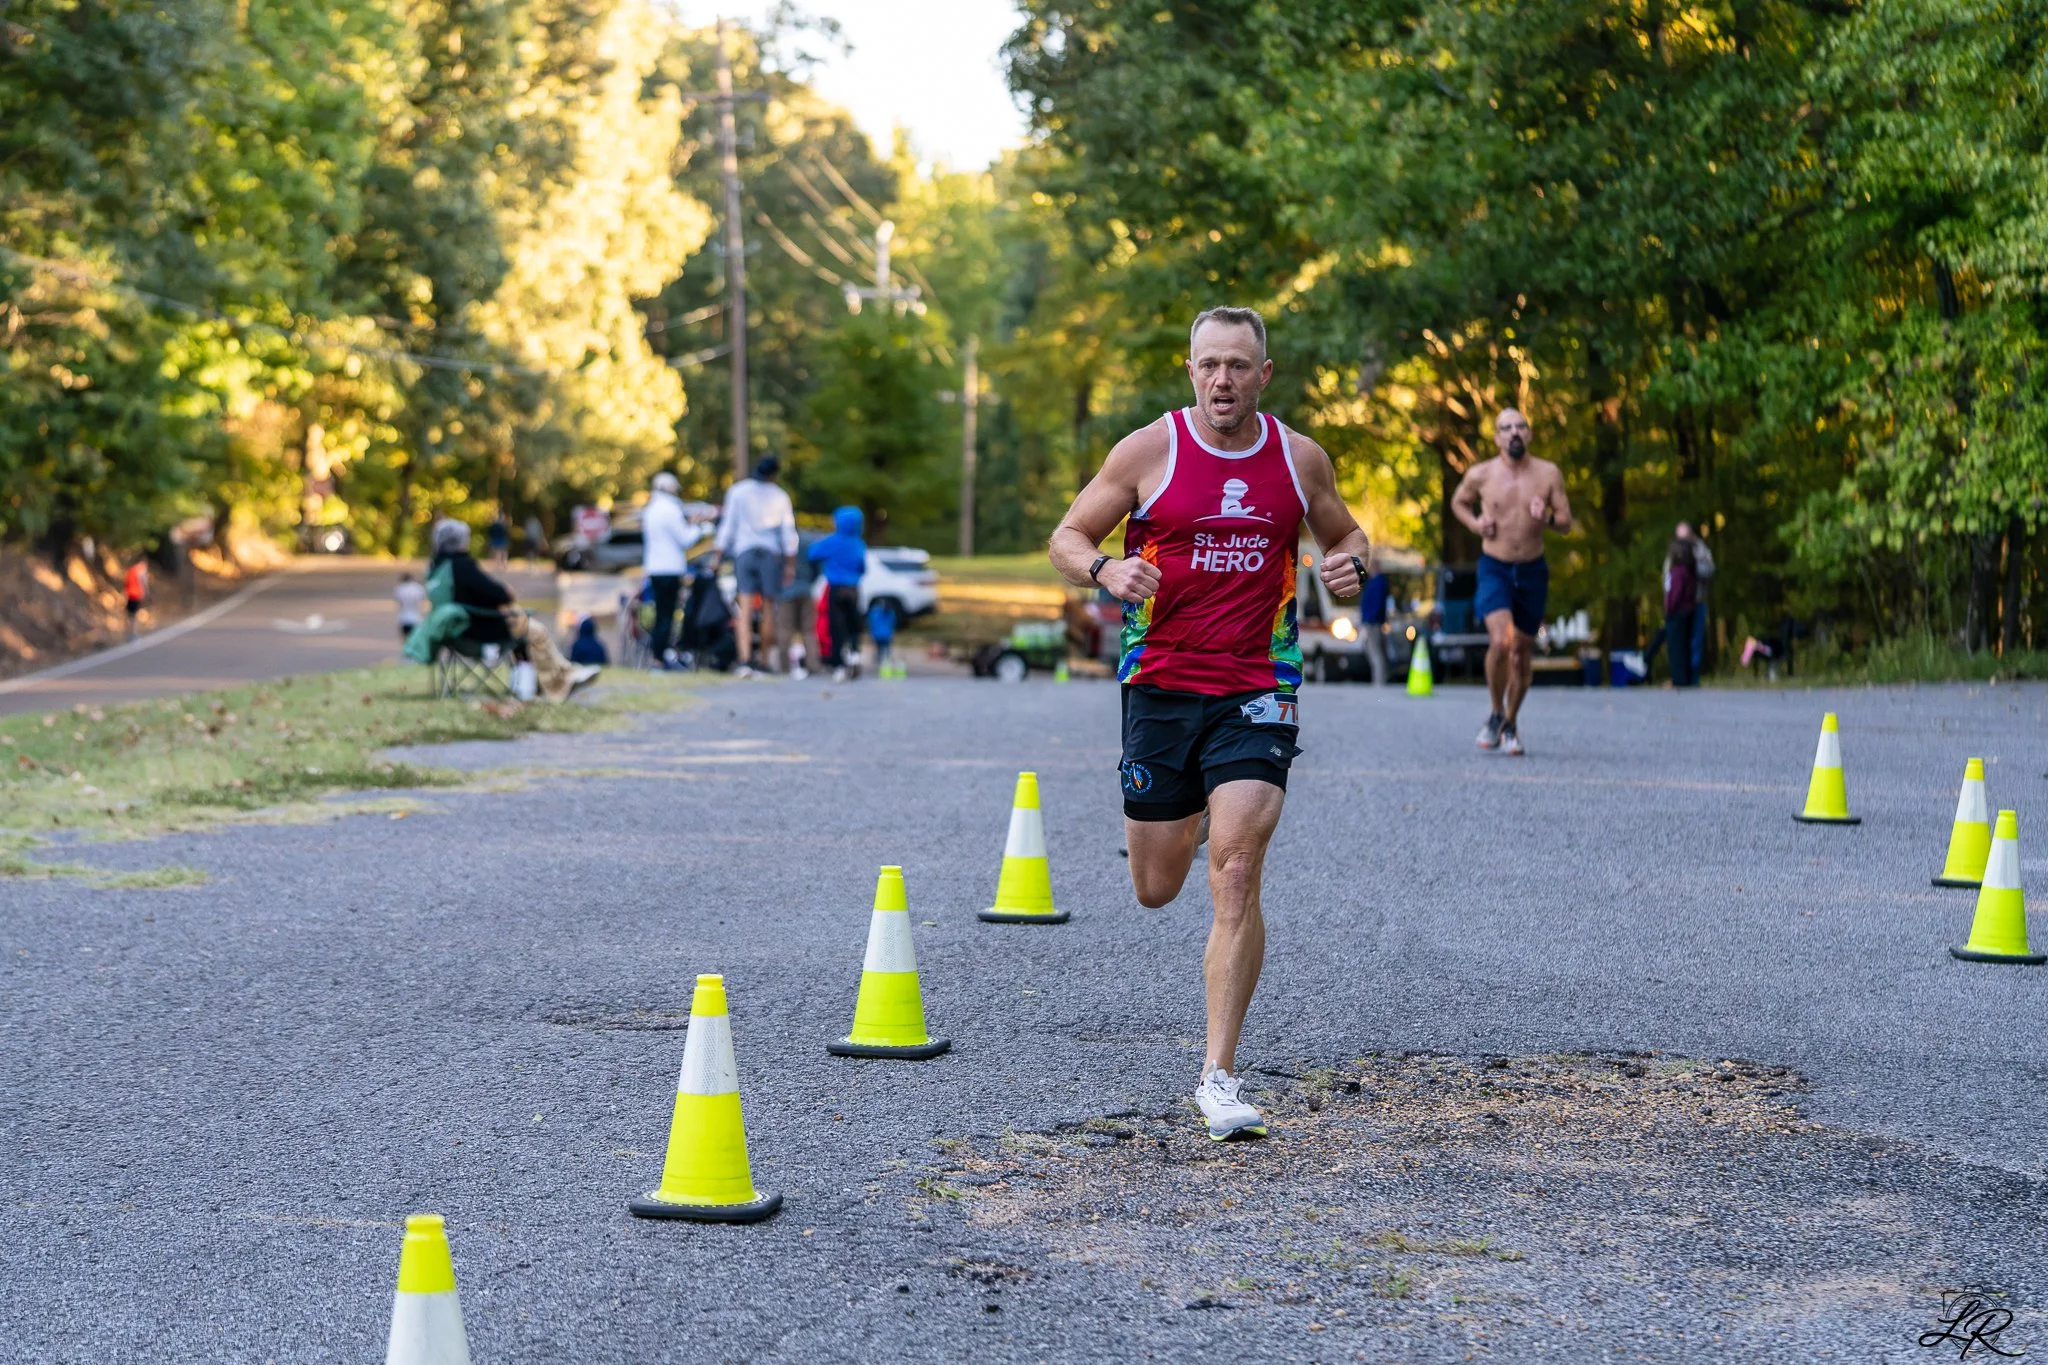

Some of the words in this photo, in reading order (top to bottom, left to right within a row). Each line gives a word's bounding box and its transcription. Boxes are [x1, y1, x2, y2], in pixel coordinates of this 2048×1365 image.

[1194, 533, 1219, 548] St.
[1223, 534, 1269, 549] Jude
[1190, 549, 1264, 573] HERO
[1277, 702, 1298, 723] 71
